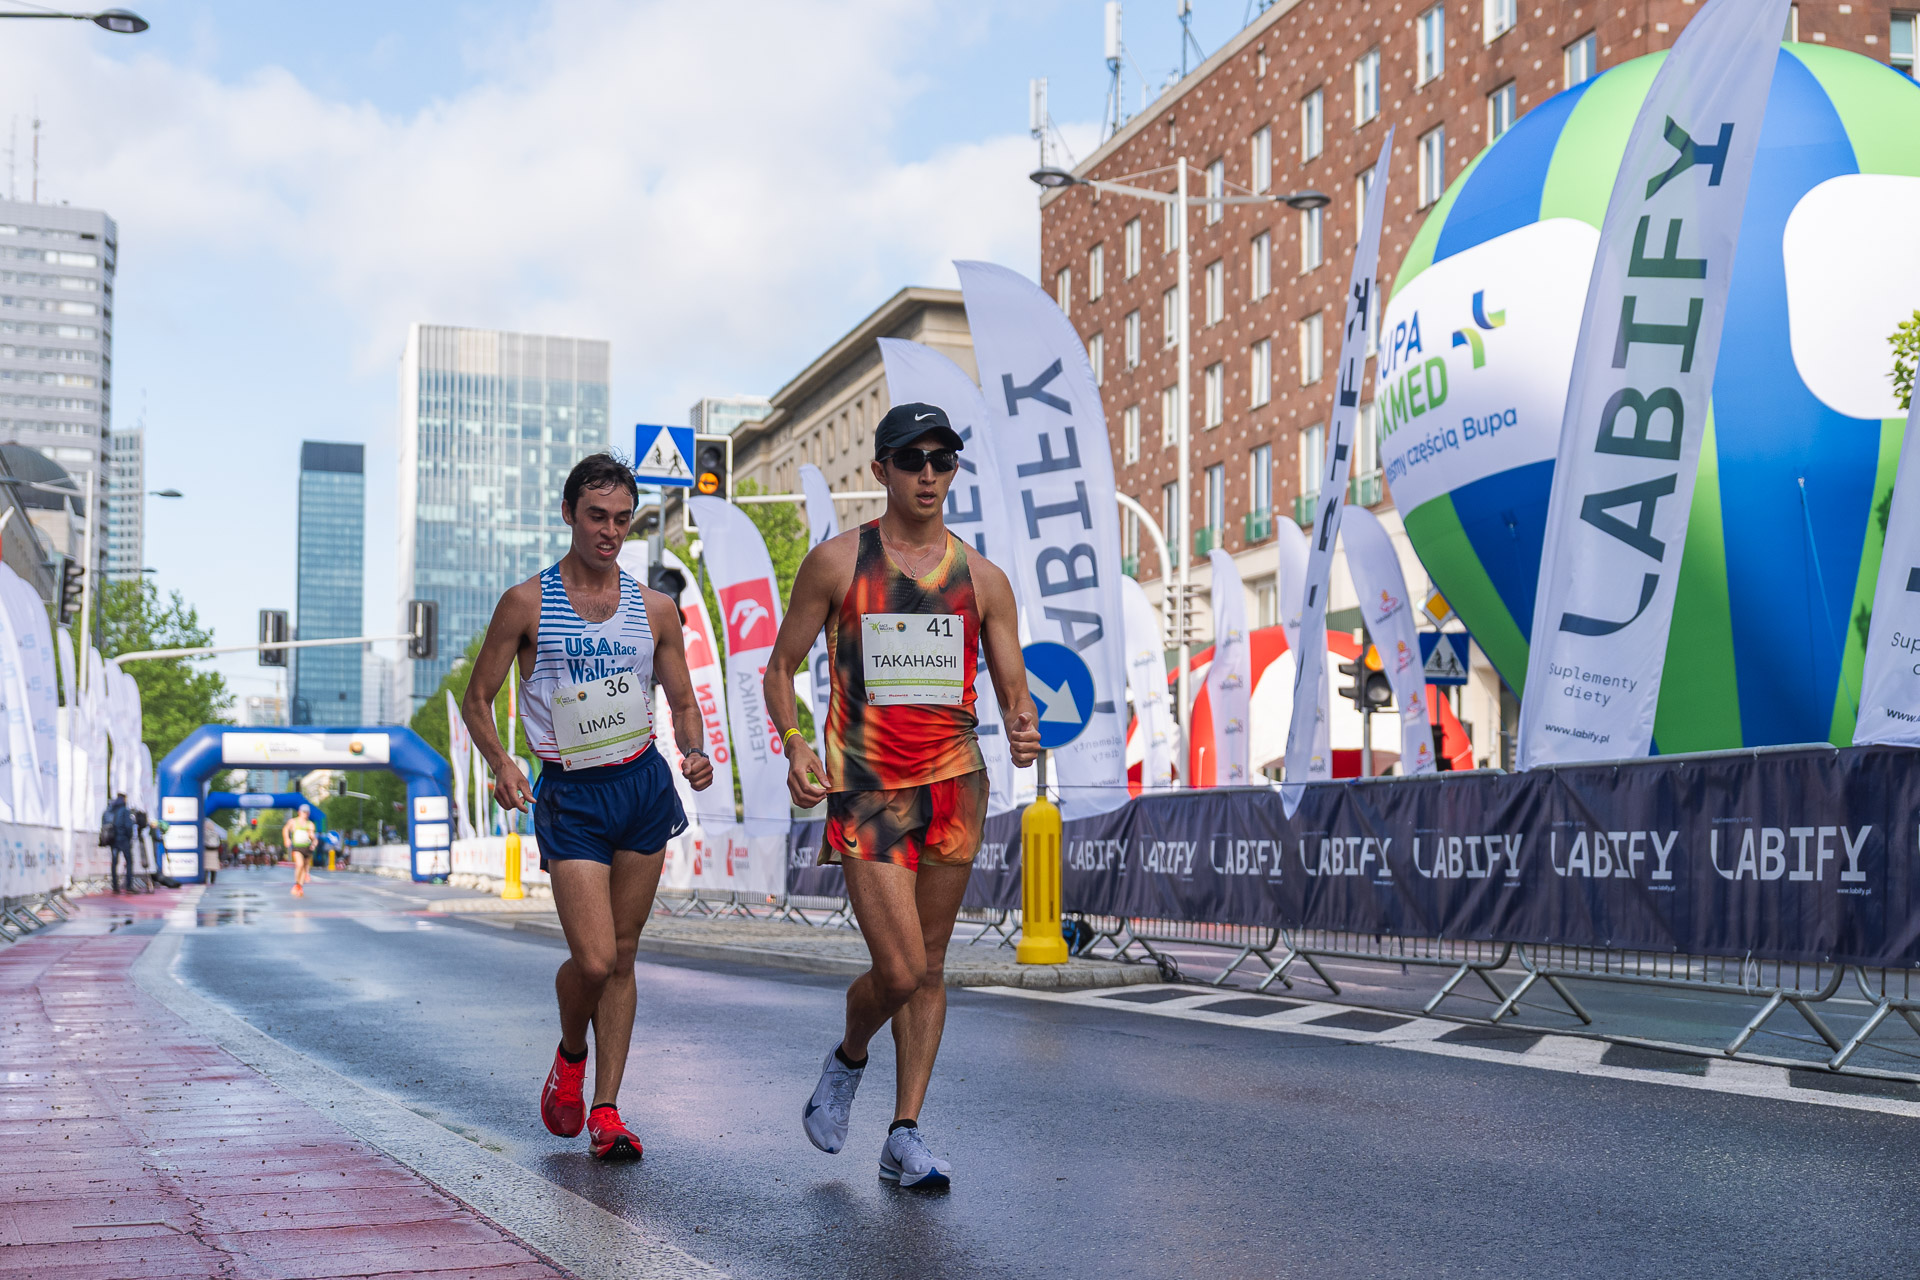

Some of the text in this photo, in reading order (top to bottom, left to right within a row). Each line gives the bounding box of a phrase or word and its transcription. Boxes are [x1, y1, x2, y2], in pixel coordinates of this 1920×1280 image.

[1378, 310, 1423, 385] UPA
[1559, 114, 1735, 636] LABIFY
[1407, 427, 1460, 466] częścią
[1463, 407, 1518, 441] Bupa
[926, 617, 954, 637] 41
[565, 637, 637, 657] USA Race
[872, 655, 956, 668] TAKAHASHI
[566, 658, 634, 685] Walki
[604, 676, 630, 698] 36
[1549, 662, 1638, 693] Suplementy
[1563, 684, 1612, 708] diety
[579, 712, 625, 734] LIMAS
[1545, 723, 1611, 744] www.labify.pl
[973, 843, 1010, 870] BIFY
[1068, 838, 1128, 870] LABIFY
[1140, 841, 1197, 874] LABIFY
[1210, 839, 1282, 876] LABIFY
[1299, 837, 1392, 877] LABIFY
[1413, 833, 1523, 879] LABIFY
[1550, 830, 1680, 879] LABIFY
[1710, 825, 1873, 882] LABIFY
[1836, 887, 1872, 896] www.labify.pl
